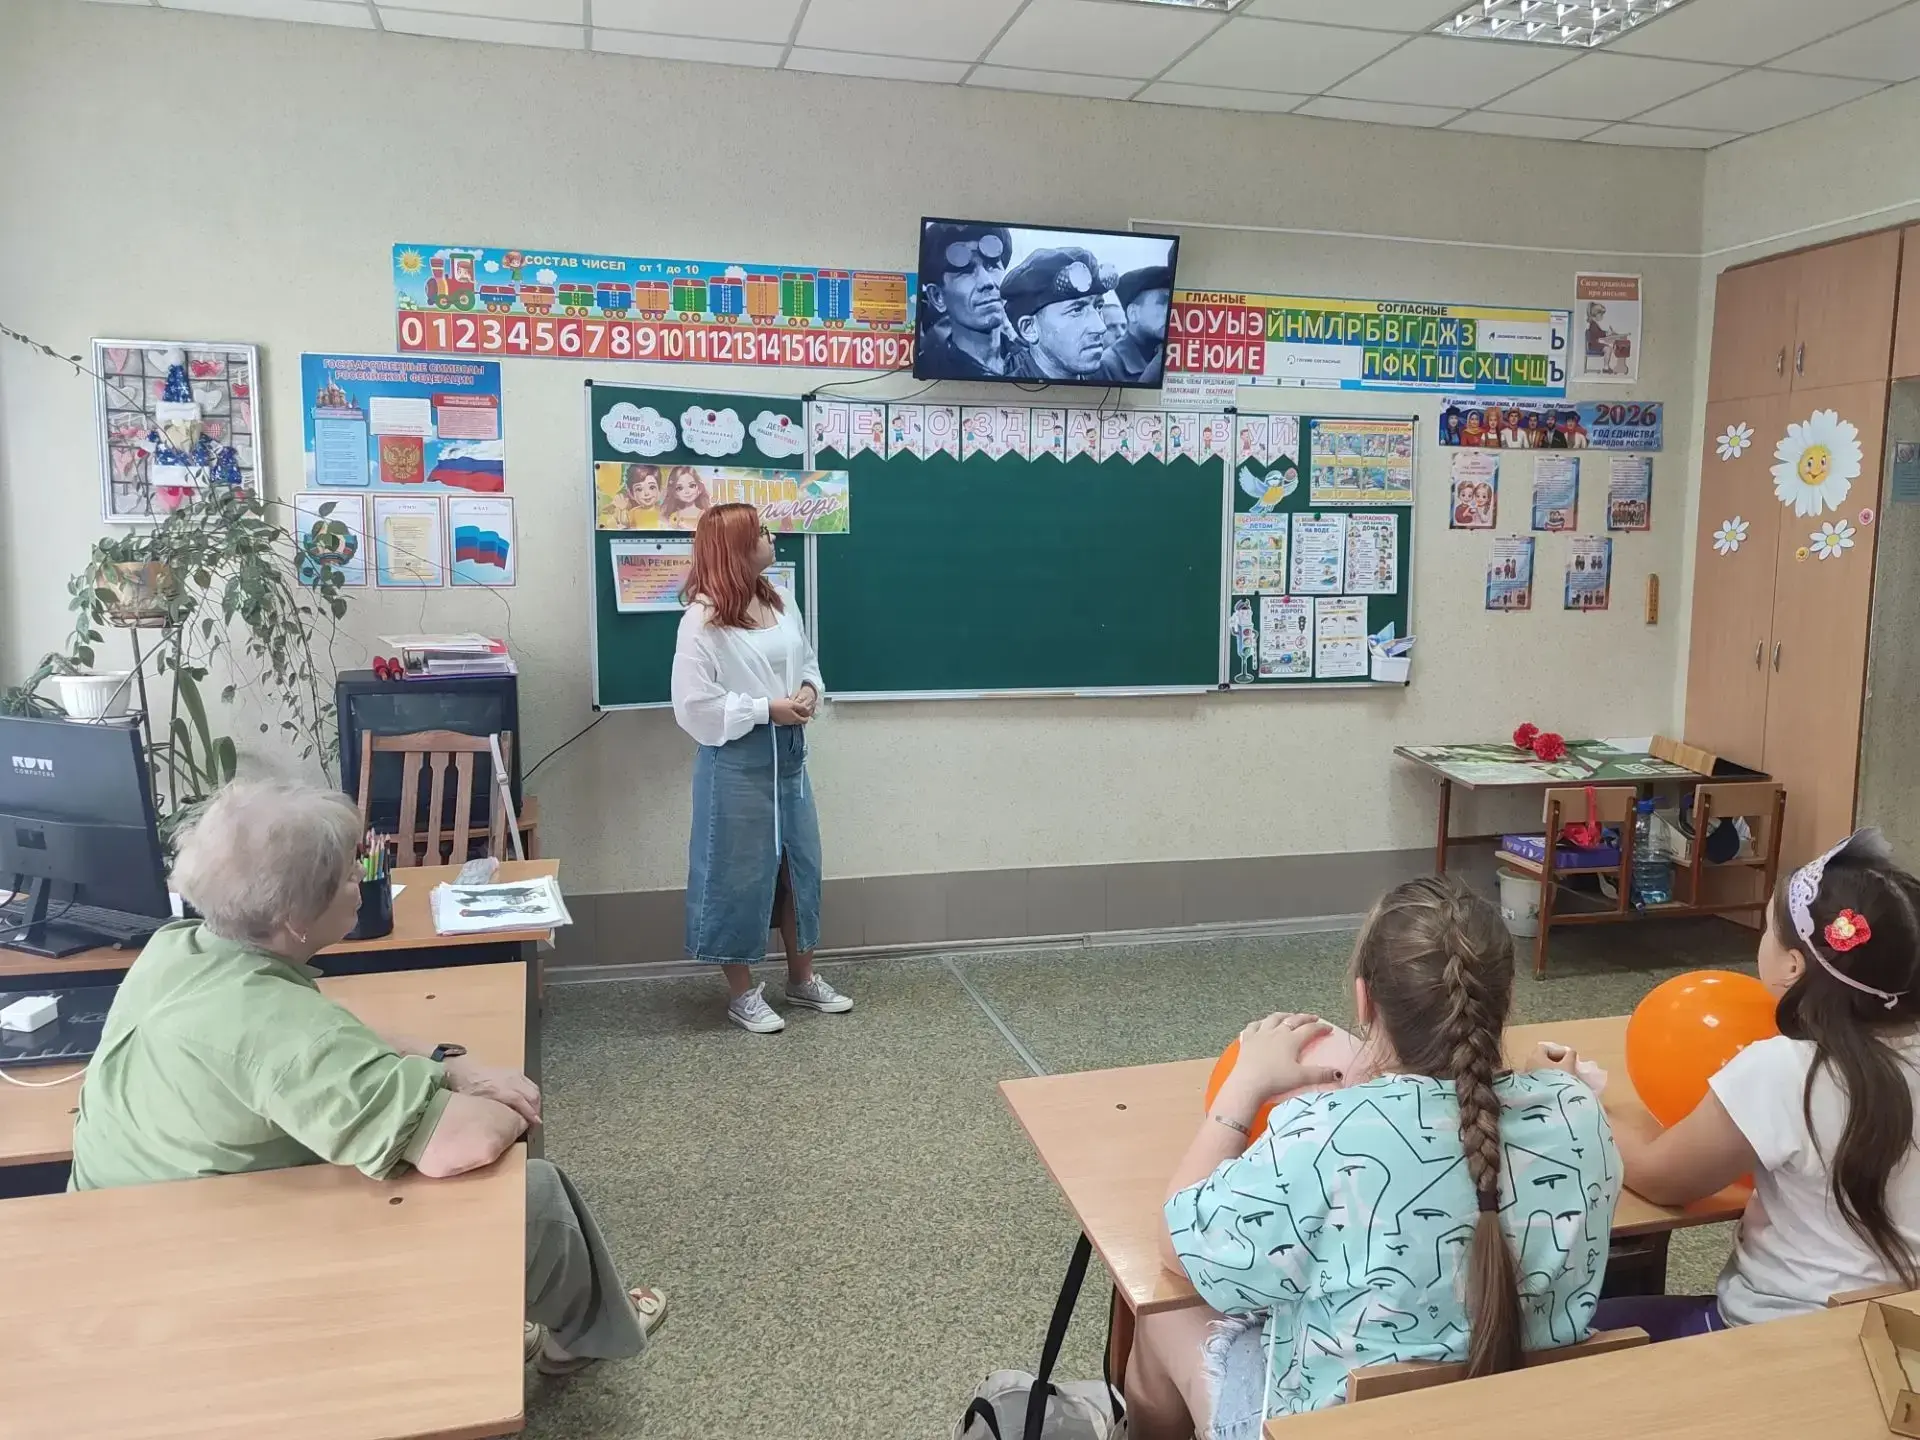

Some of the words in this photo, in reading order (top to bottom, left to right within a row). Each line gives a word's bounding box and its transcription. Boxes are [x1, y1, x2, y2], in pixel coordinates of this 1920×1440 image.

[524, 255, 578, 267] СОСТАВ
[581, 257, 626, 271] ЧИСЕЛ
[639, 264, 652, 272] от
[655, 263, 662, 272] 1
[666, 265, 681, 275] до
[684, 264, 699, 275] 10
[1186, 292, 1246, 304] ГЛАСНЫЕ
[1377, 303, 1448, 316] СОГЛАСНЫЕ
[660, 328, 682, 357] 10
[685, 329, 706, 358] 11
[709, 330, 732, 359] 12
[733, 331, 756, 360] 13
[757, 332, 780, 361] 14
[782, 334, 804, 362] 15
[806, 334, 828, 363] 16
[829, 335, 851, 364] 17
[852, 336, 874, 365] 18
[876, 337, 898, 366] 19
[323, 359, 428, 374] ГОСУДАРСТВЕННЫЕ
[429, 363, 484, 376] СИМВОЛЫ
[335, 369, 408, 382] РОССИЙСКОЙ
[410, 373, 474, 386] ФЕДЕРАЦИИ
[1592, 404, 1656, 426] 2026
[1593, 429, 1610, 438] ГОД
[1612, 430, 1655, 439] ЕДИНСТВА
[711, 478, 798, 505] ЛЕТНИЙ
[758, 497, 840, 529] лагерь
